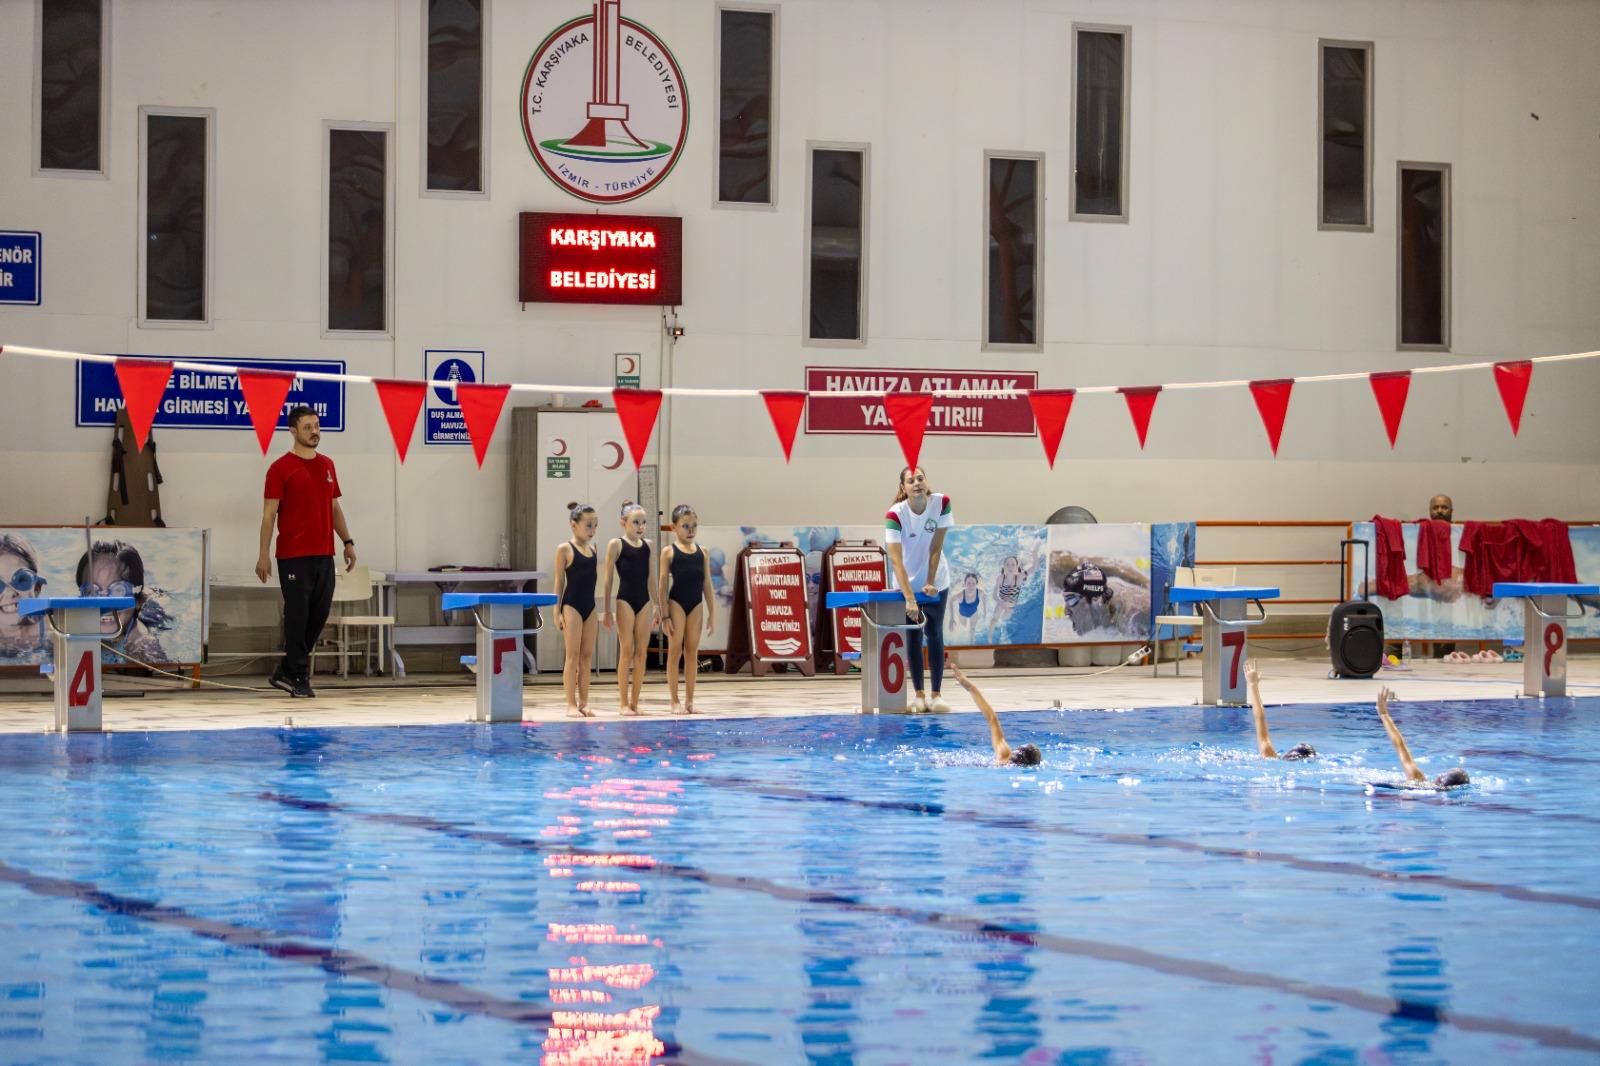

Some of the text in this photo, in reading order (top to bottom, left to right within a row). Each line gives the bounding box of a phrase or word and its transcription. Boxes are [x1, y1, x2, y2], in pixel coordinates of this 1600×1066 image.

[532, 32, 679, 115] T.C. KARŞIYAKA BELEDİYESİ
[558, 163, 589, 188] İZMİR
[605, 167, 655, 191] TÜRKİYE
[550, 228, 656, 250] KARŞIYAKA
[0, 246, 32, 264] NÖR
[550, 268, 656, 289] BELEDİYESİ
[826, 376, 1018, 400] HAVUZA ATLAMAK
[164, 396, 229, 415] GİRMESİ
[430, 411, 446, 420] DUŞ
[860, 404, 984, 428] YATIR!!!
[441, 422, 468, 430] HAVUZA
[754, 574, 800, 586] CANKURTARAN
[837, 570, 881, 582] CANKURTARAN
[769, 589, 787, 600] YOK!!
[1083, 584, 1104, 592] PHELPS
[766, 605, 793, 616] HAVUZA
[760, 619, 801, 632] GİRMEYİNİZ!
[880, 631, 905, 694] 6
[1221, 631, 1245, 690] 7
